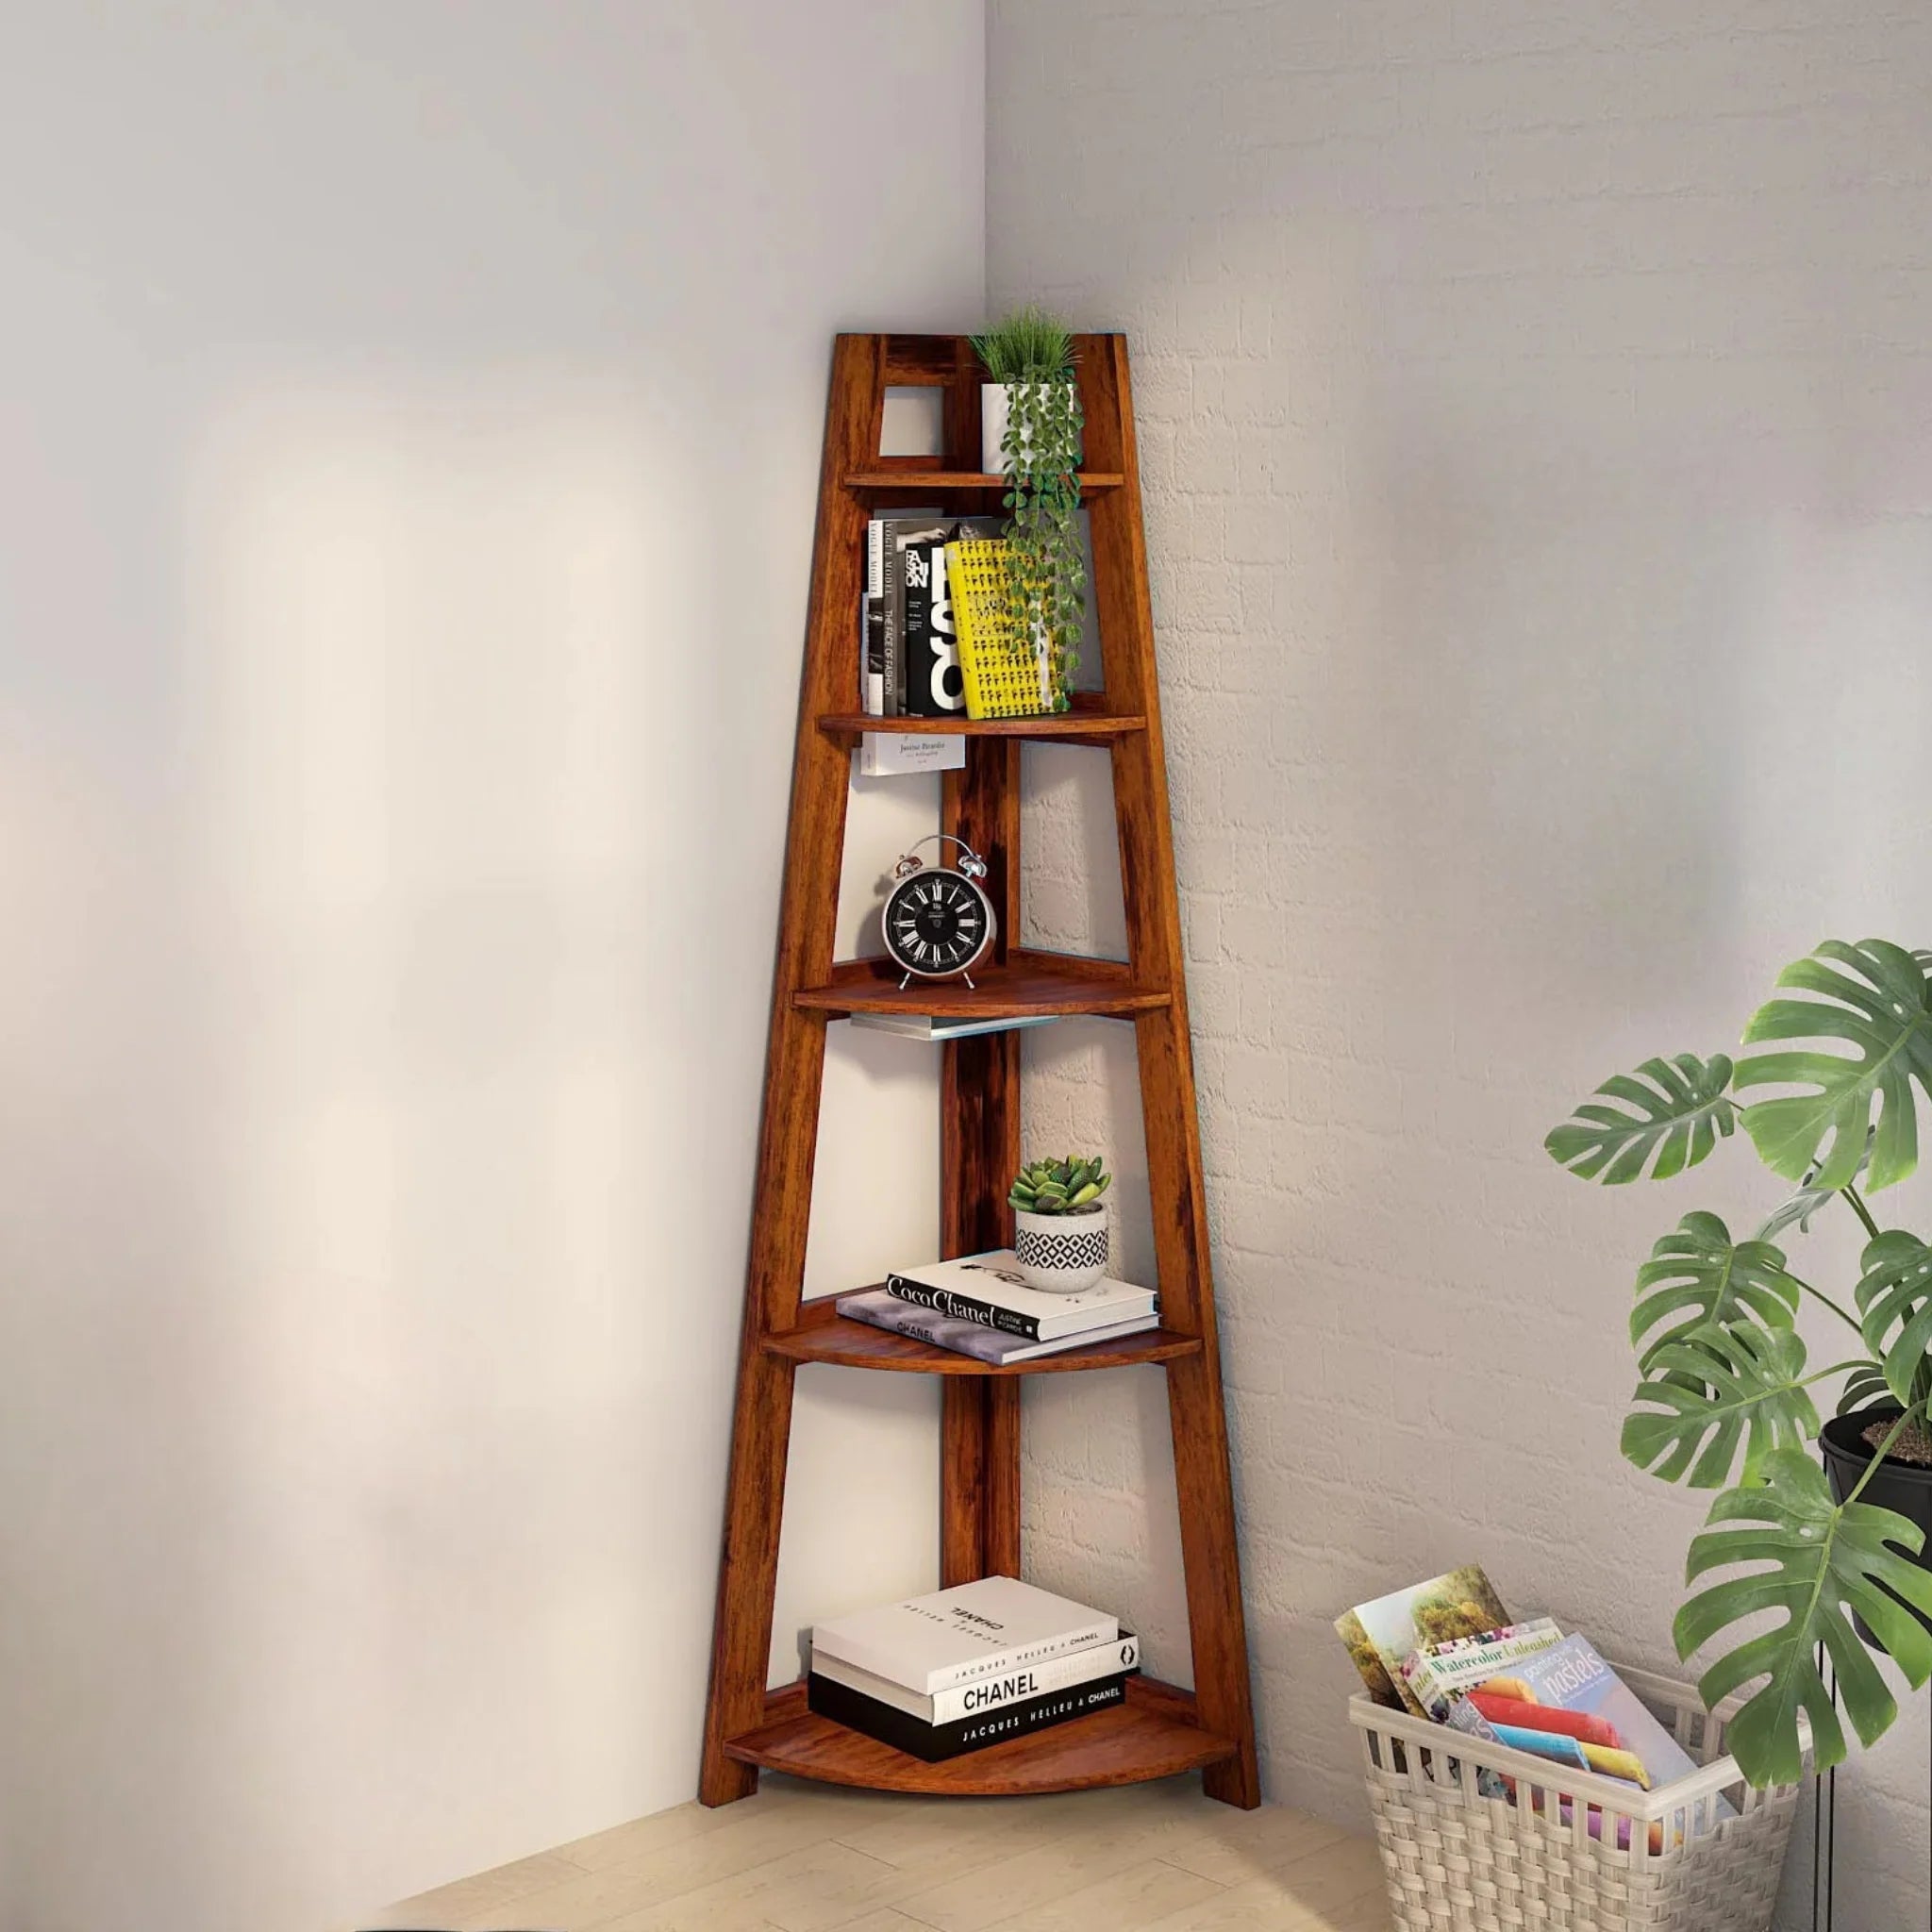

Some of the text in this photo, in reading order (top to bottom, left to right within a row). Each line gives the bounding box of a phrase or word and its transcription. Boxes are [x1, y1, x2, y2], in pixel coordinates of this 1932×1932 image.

[885, 523, 893, 593] VOGUE MODEL
[885, 610, 893, 625] THE
[885, 625, 893, 647] FACE
[885, 660, 893, 695] FASHION
[888, 1276, 995, 1327] Coco Chanel
[896, 1322, 935, 1342] CHANEL
[950, 1607, 1004, 1630] CHANEL
[955, 1658, 1007, 1680] JACQUES
[1016, 1644, 1056, 1661] HELLEU
[1070, 1632, 1099, 1646] CHANEL
[1431, 1649, 1503, 1674] Watercolor
[1503, 1630, 1561, 1659] Unleashed
[963, 1673, 1039, 1711] CHANEL
[1542, 1646, 1605, 1707] pastels
[962, 1716, 1020, 1742] JACQUES
[1030, 1701, 1073, 1722] HELLEU
[1088, 1687, 1121, 1705] CHANEL
